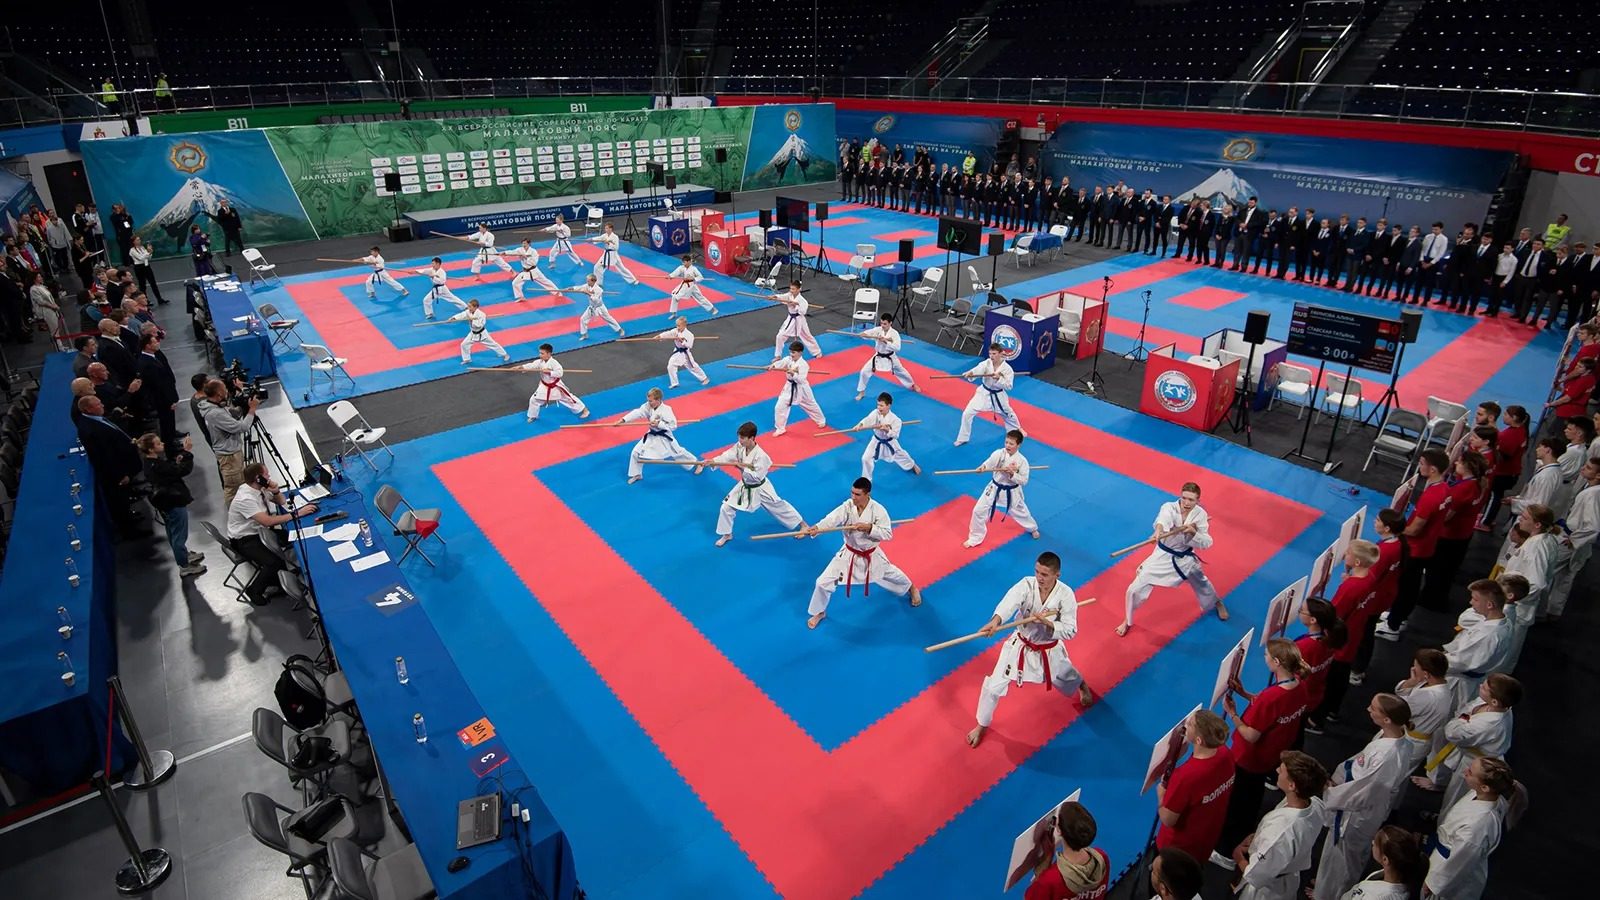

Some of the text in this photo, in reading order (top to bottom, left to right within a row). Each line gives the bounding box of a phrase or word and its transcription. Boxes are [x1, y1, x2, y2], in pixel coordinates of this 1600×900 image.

[570, 103, 588, 112] B11
[227, 118, 248, 129] B11
[483, 124, 617, 138] МАЛАХИТОВЫЙ ПОЯС
[1070, 160, 1161, 173] МАЛАХИТОВЫЙ ПОЯС
[301, 171, 366, 180] МАЛАХИТОВЫЙ
[1296, 182, 1431, 202] МАЛАХИТОВЫЙ ПОЯС
[535, 213, 556, 221] ПОЯС
[1387, 342, 1395, 352] 0
[375, 592, 402, 607] 4
[481, 753, 495, 763] 3
